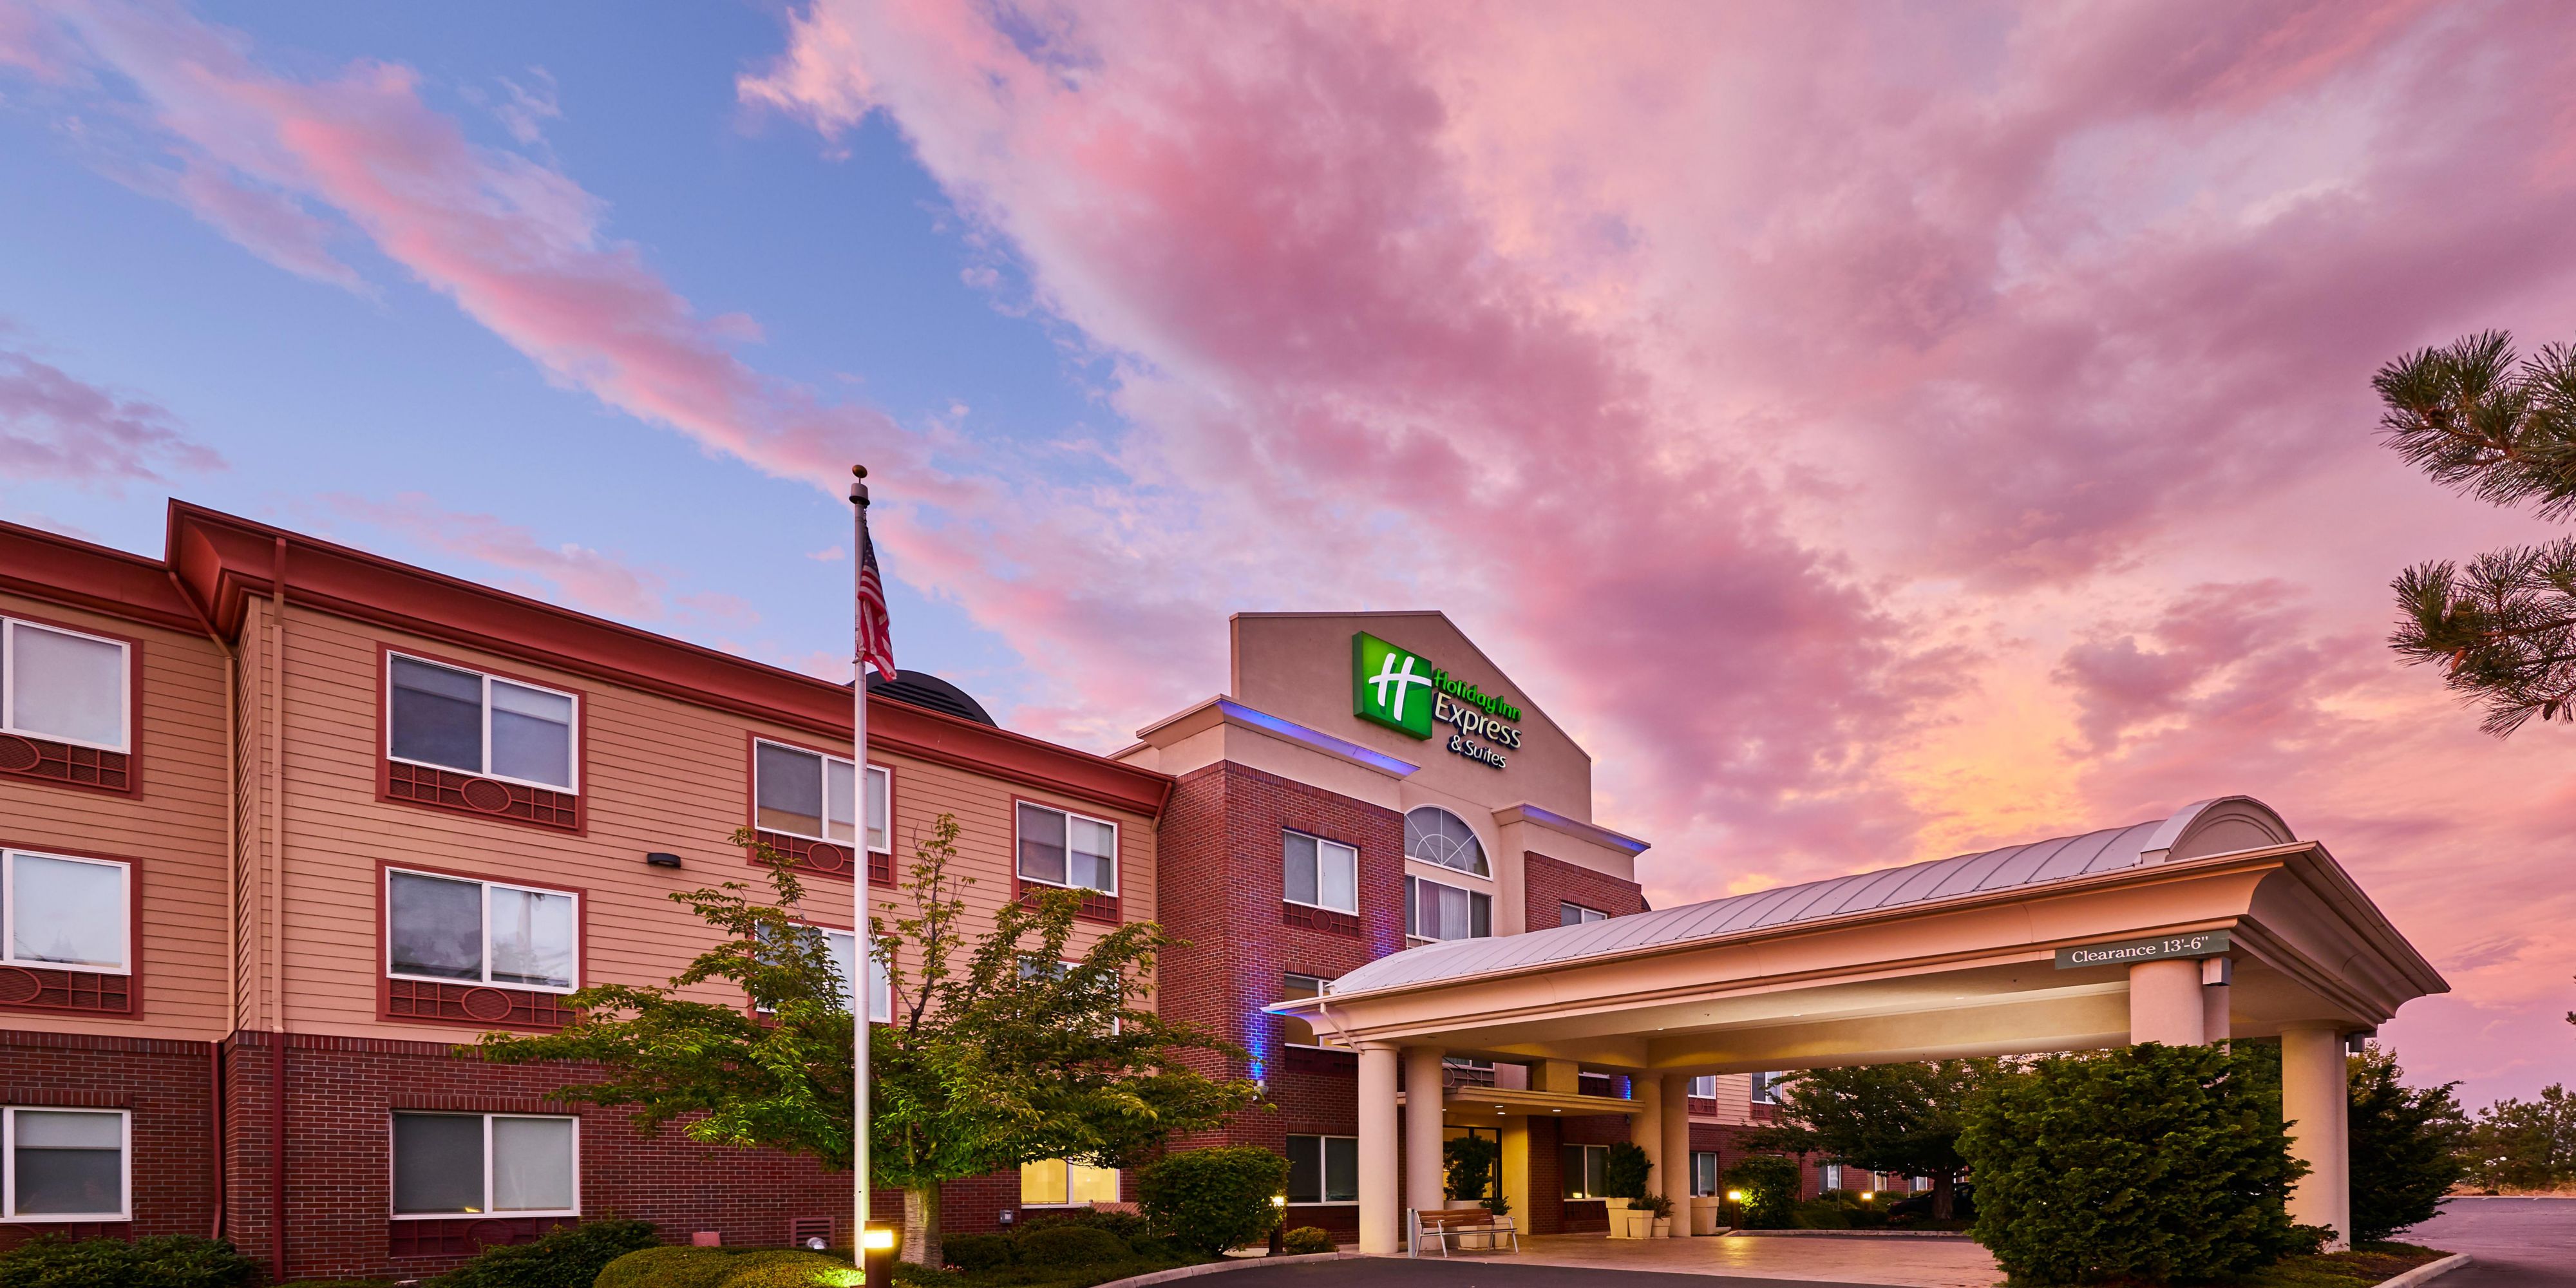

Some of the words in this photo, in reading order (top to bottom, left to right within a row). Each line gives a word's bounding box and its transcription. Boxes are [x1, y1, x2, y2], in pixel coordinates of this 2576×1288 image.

[1434, 668, 1497, 714] Holiday
[1499, 696, 1522, 721] Inn
[1434, 692, 1522, 748] Express
[1450, 735, 1462, 752] &
[1464, 740, 1506, 768] Suites
[2072, 944, 2156, 963] Clearance
[2163, 936, 2209, 953] 13'-6"
